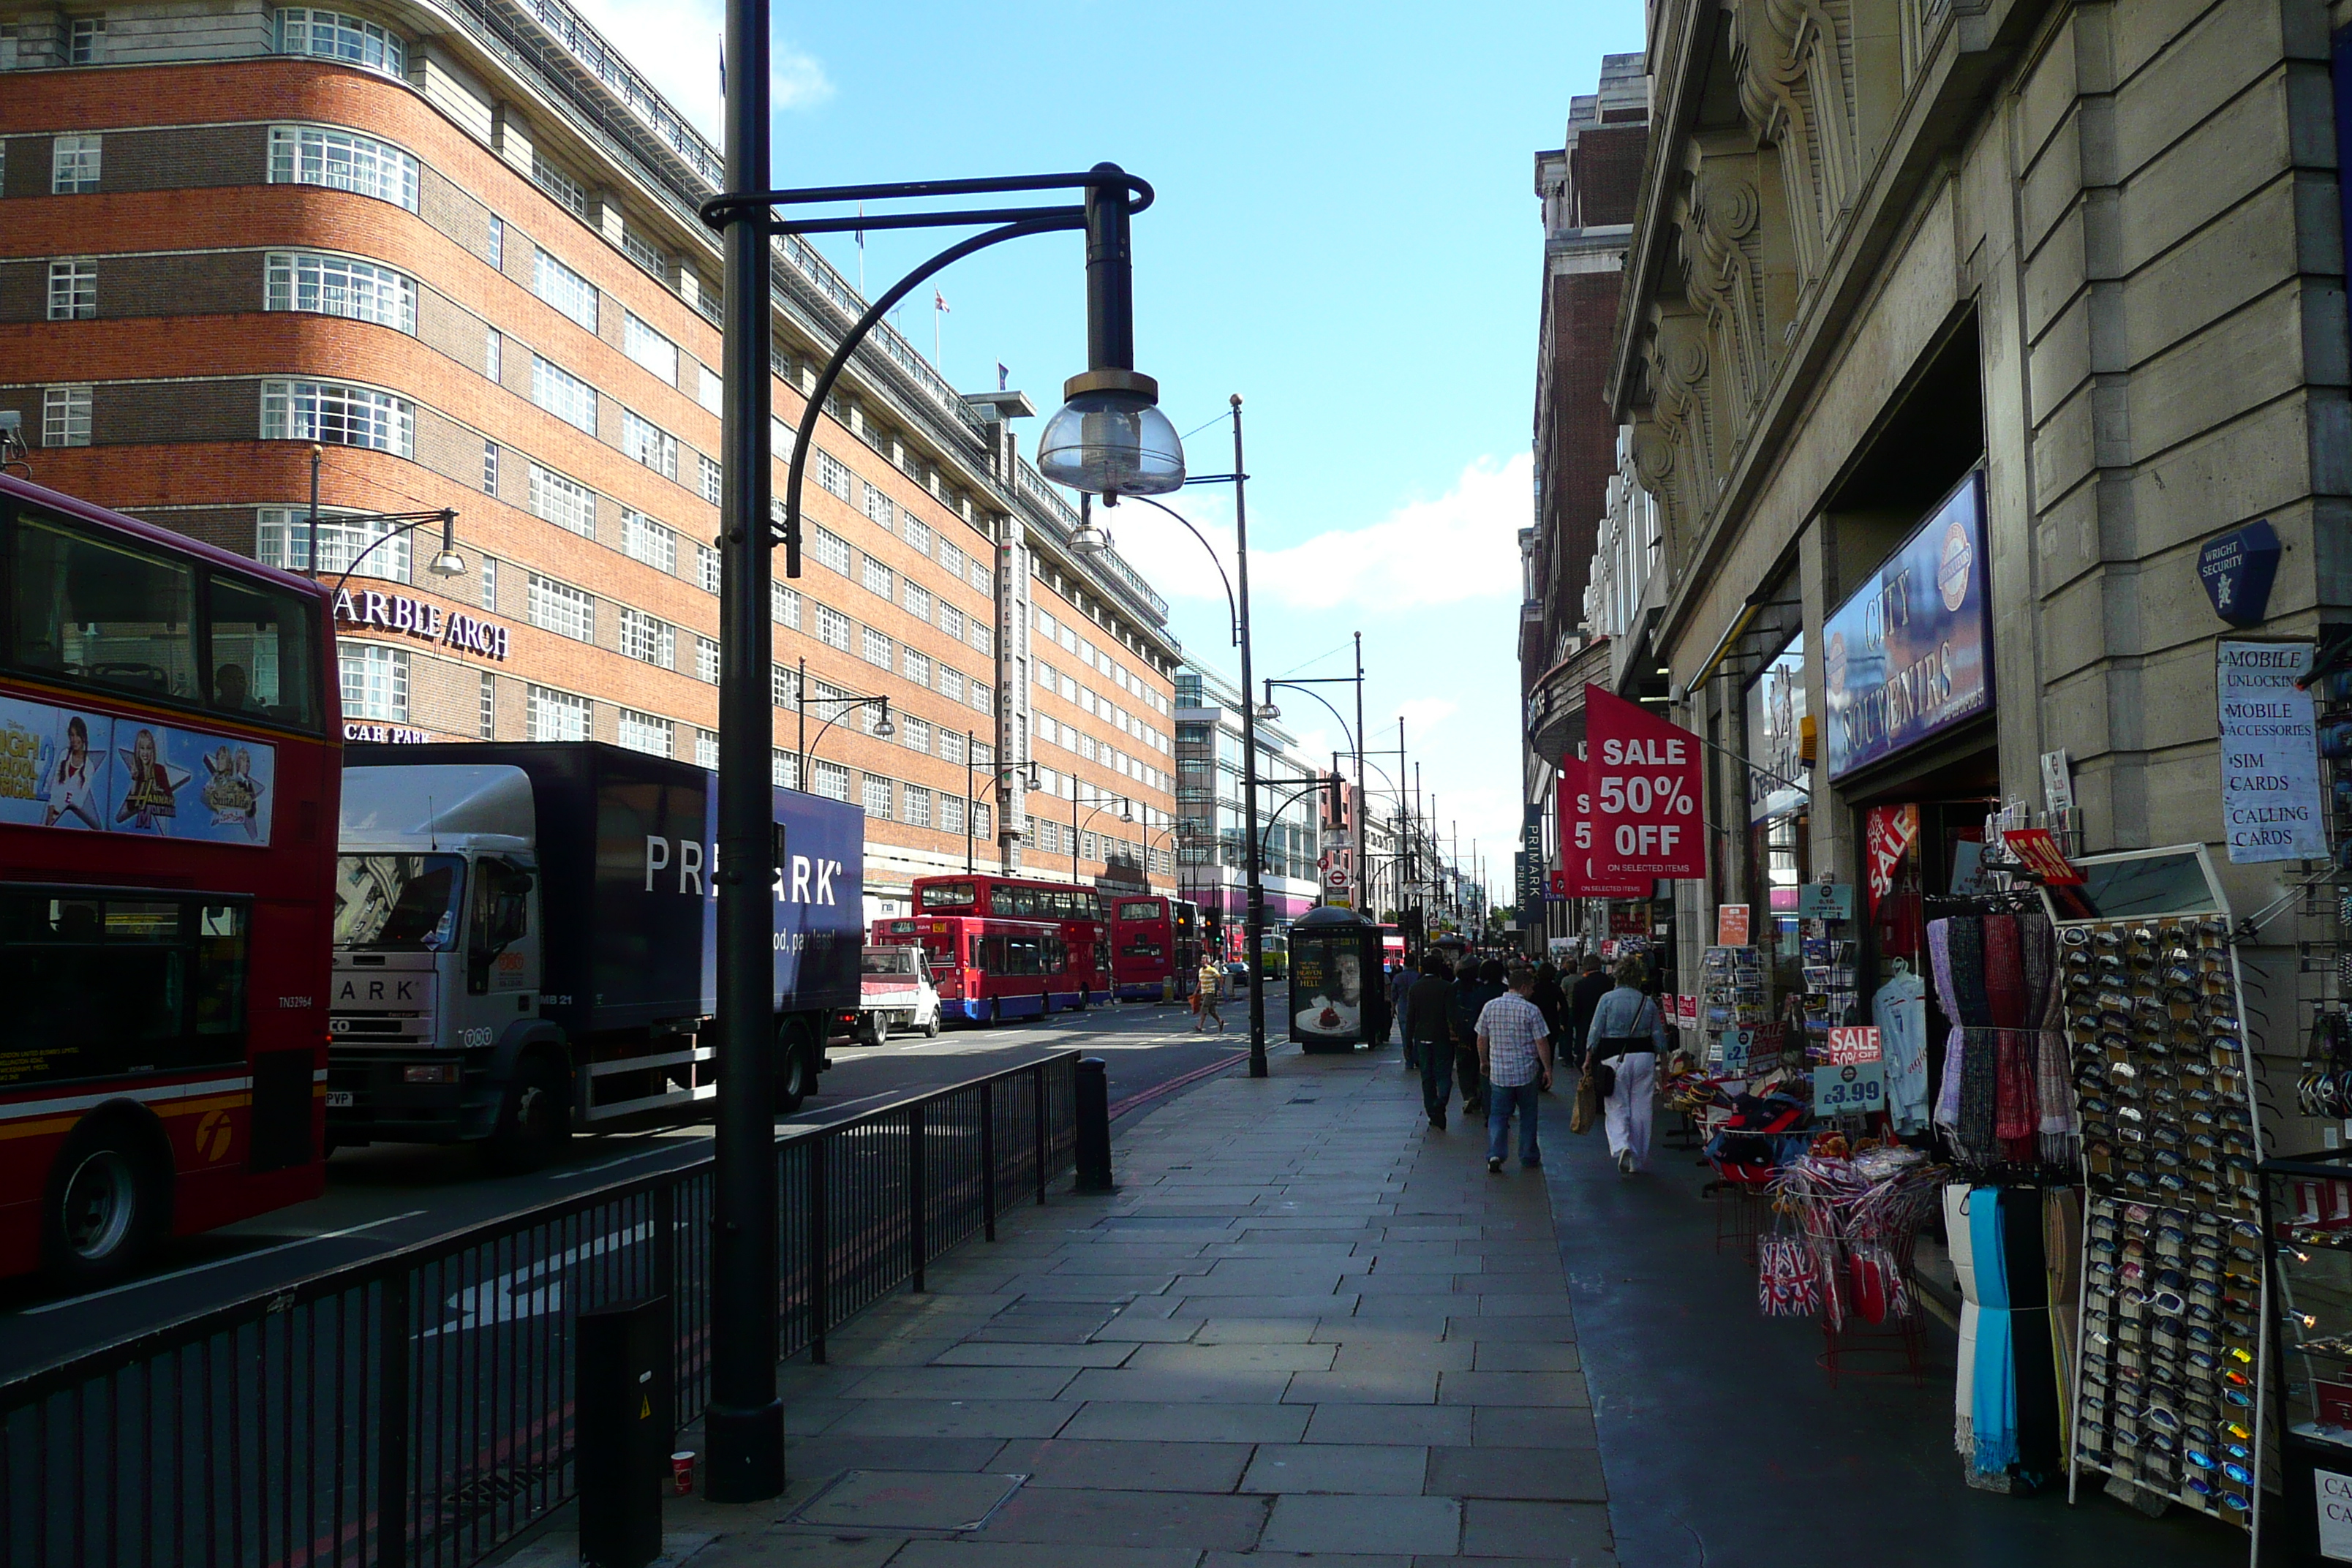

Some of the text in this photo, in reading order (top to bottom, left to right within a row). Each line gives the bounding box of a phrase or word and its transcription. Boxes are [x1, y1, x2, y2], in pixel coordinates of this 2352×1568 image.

[2205, 541, 2237, 562] WRIGHT
[2202, 554, 2242, 578] SECURITY
[1003, 566, 1011, 662] THISTLE
[1866, 568, 1910, 652] CITY
[448, 611, 510, 657] ARCH
[2228, 651, 2301, 668] MOBILE
[1844, 640, 1952, 755] SOUVENIRS
[1003, 681, 1011, 761] HOTELS
[2228, 704, 2292, 718] MOBILE
[344, 724, 385, 742] CAR
[2228, 725, 2311, 736] ACCESSORIES
[1603, 739, 1686, 766] SALE
[2233, 753, 2264, 768] SIM
[37, 734, 54, 802] 2
[2231, 776, 2289, 791] CARDS
[1599, 776, 1693, 815] 50%
[2233, 807, 2309, 824] CALLING
[1615, 824, 1681, 856] OFF
[2236, 829, 2292, 847] CARDS
[1320, 859, 1327, 868] P
[1528, 825, 1540, 897] PRIMARK
[1871, 809, 1917, 899] SALE
[1517, 864, 1526, 912] PRIMARK
[792, 934, 810, 956] pay
[813, 928, 835, 949] less!
[279, 996, 312, 1008] TN32964
[559, 995, 572, 1005] 21
[464, 1027, 492, 1047] TNT
[1754, 1023, 1784, 1042] SALE
[1831, 1028, 1878, 1052] SALE
[1833, 1052, 1856, 1066] 50%
[1824, 1081, 1879, 1104] £3.99
